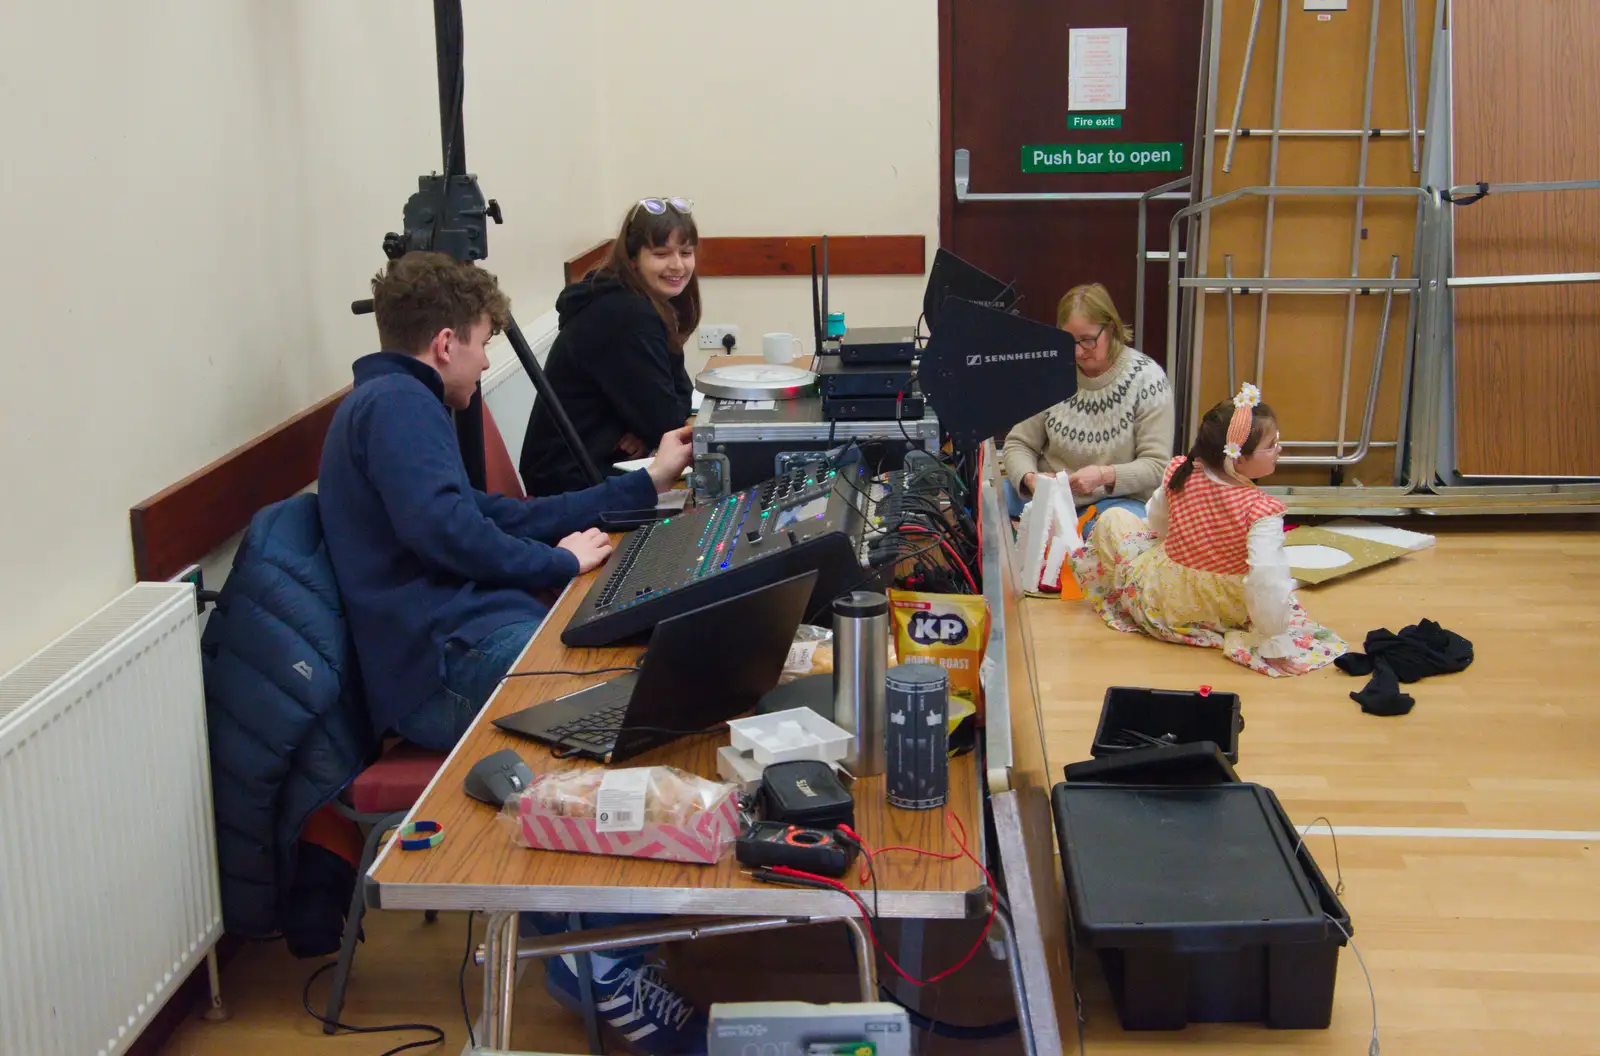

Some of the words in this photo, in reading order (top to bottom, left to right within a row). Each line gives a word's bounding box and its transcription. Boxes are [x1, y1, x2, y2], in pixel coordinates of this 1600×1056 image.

[1073, 117, 1093, 126] Fire
[1095, 117, 1115, 126] exit
[1033, 149, 1072, 165] Push
[1077, 149, 1104, 165] bar
[1108, 149, 1125, 164] to
[1130, 150, 1171, 166] open
[984, 350, 1058, 363] SENNHEISER
[915, 618, 963, 640] KP
